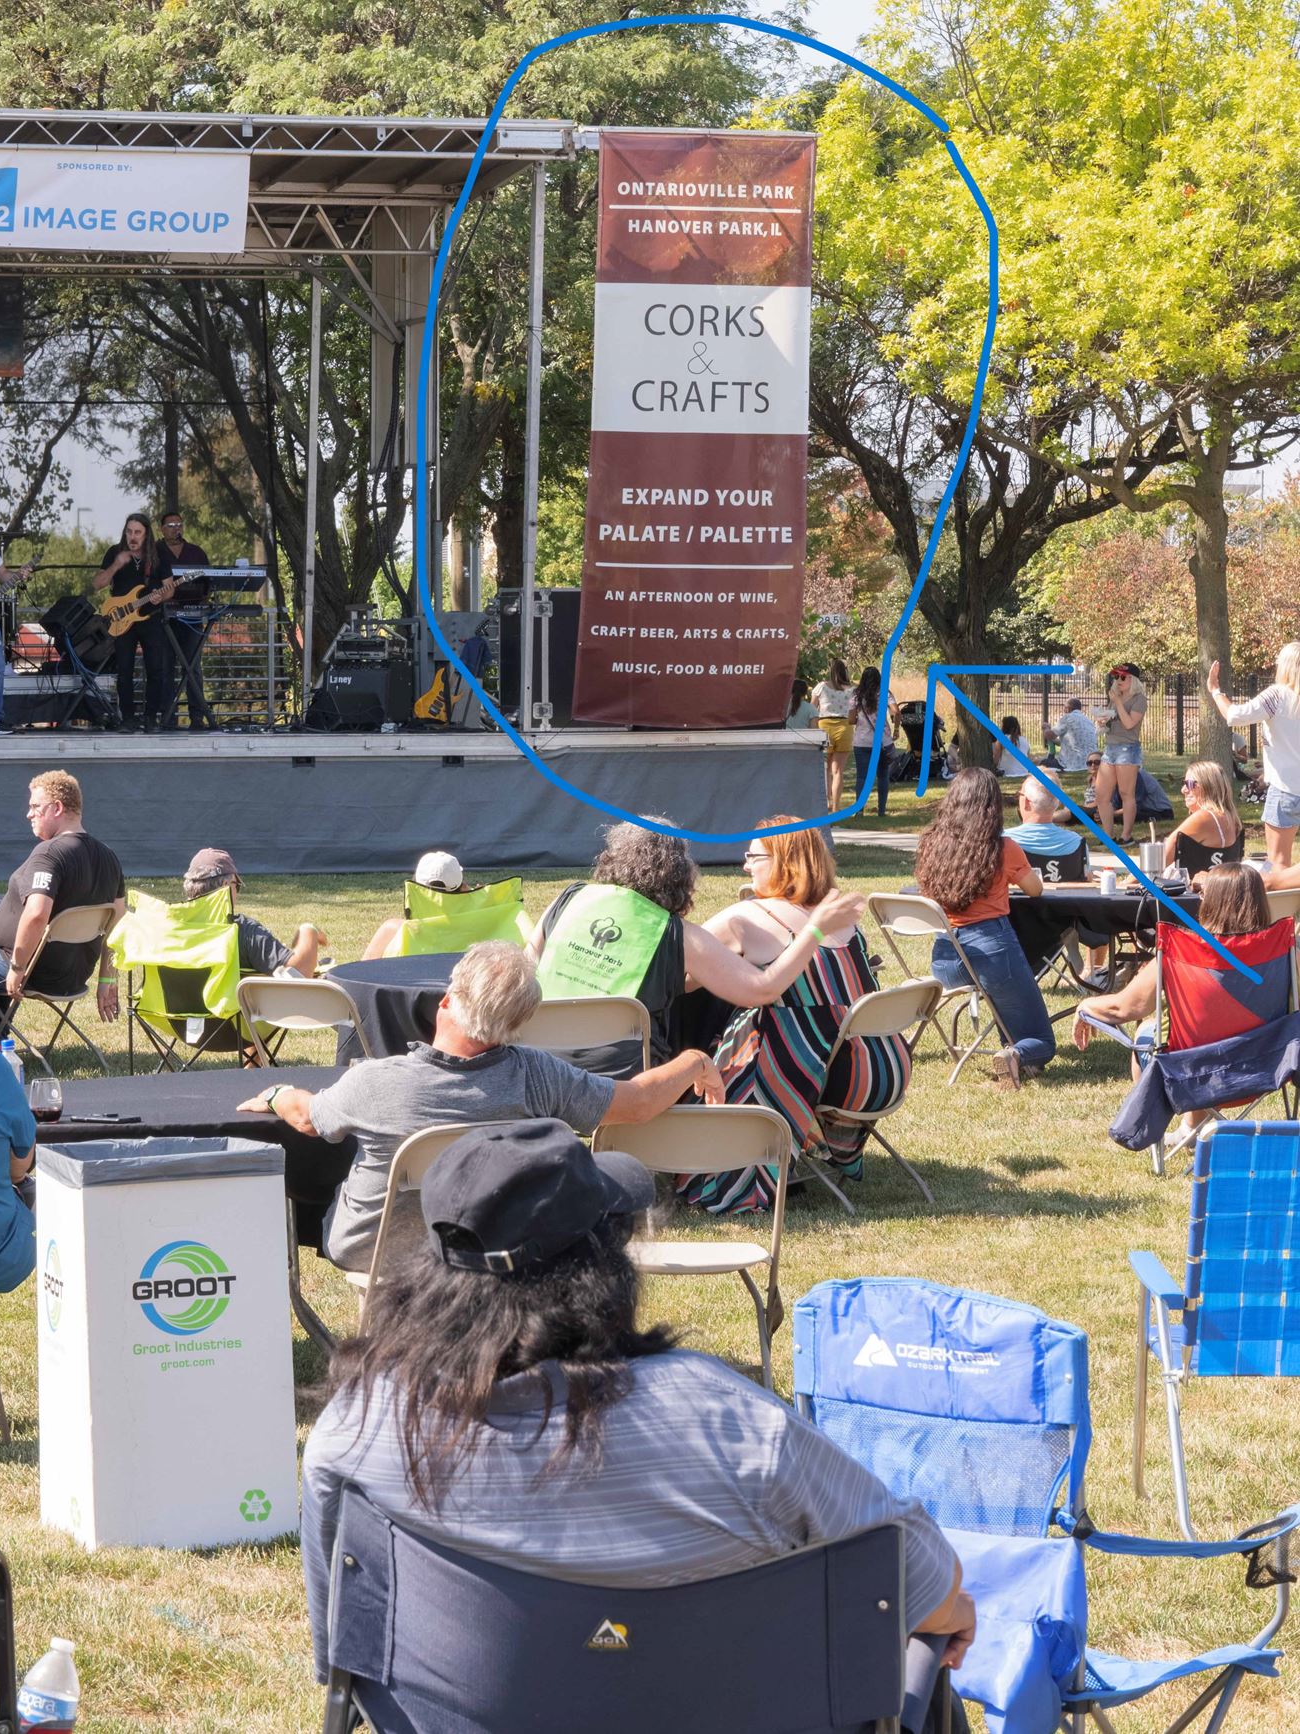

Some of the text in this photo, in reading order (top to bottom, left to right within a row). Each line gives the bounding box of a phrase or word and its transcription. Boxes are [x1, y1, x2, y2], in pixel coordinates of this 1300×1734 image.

[57, 162, 132, 172] SPONSORED BY:
[617, 182, 795, 200] ONTARIOVILLE PARK
[23, 206, 118, 231] IMAGE
[127, 210, 230, 233] GROUP
[628, 219, 783, 238] HANOVER PARK, IL
[644, 303, 765, 338] CORKS
[687, 341, 720, 375] &
[631, 380, 770, 414] CRAFTS
[621, 488, 774, 507] EXPAND YOUR
[598, 524, 794, 544] PALATE / PALETTE
[604, 590, 778, 605] AN AFTERNOON OF WINE,
[590, 625, 790, 641] CRAFT BEER, ARTS & CRAFTS,
[611, 661, 765, 676] MUSIC, FOOD & MORE!
[603, 954, 623, 968] Park
[132, 1275, 237, 1301] GROOT
[133, 1337, 242, 1356] Groot Industries
[160, 1357, 215, 1372] groot.com
